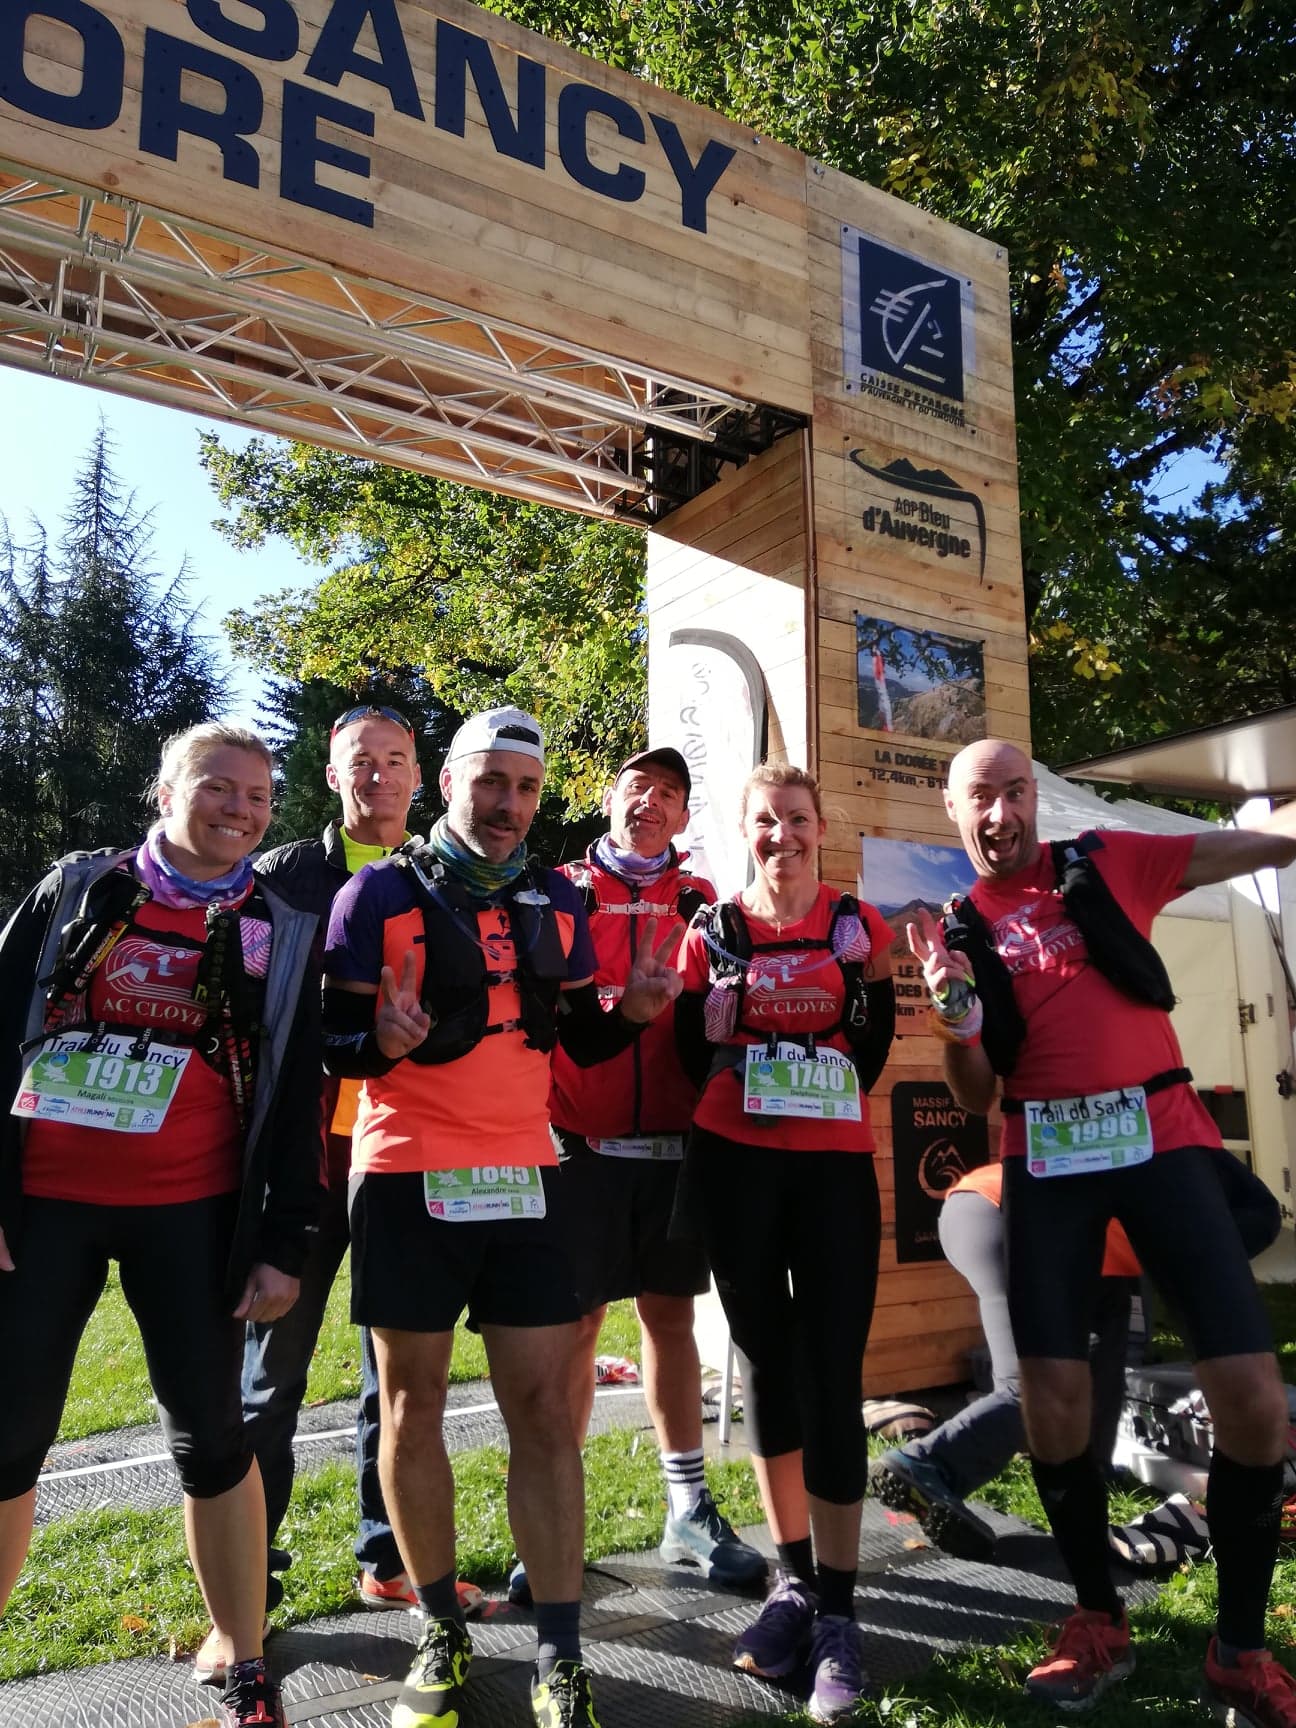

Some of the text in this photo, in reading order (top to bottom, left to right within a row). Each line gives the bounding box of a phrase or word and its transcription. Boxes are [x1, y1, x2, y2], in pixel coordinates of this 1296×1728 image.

[860, 372, 900, 394] CAISSE
[919, 500, 950, 529] Bleu
[862, 506, 971, 558] d'Auvergne
[875, 750, 892, 764] LA
[895, 752, 937, 771] DORÉE
[898, 965, 914, 978] LE
[896, 984, 922, 998] DES
[103, 998, 207, 1027] AC CLOYE
[751, 1000, 837, 1016] AC CLOYES
[50, 1036, 87, 1053] Trai
[125, 1043, 186, 1070] Sncy
[787, 1048, 806, 1061] du
[85, 1056, 164, 1096] 1913
[787, 1062, 845, 1092] 1740
[77, 1088, 107, 1101] Magali
[912, 1097, 950, 1108] MASSIF
[913, 1110, 968, 1128] SANCY
[1029, 1103, 1065, 1123] Trail
[1093, 1095, 1144, 1117] Sancy
[1068, 1111, 1138, 1144] 1996
[471, 1187, 507, 1196] Alexandre
